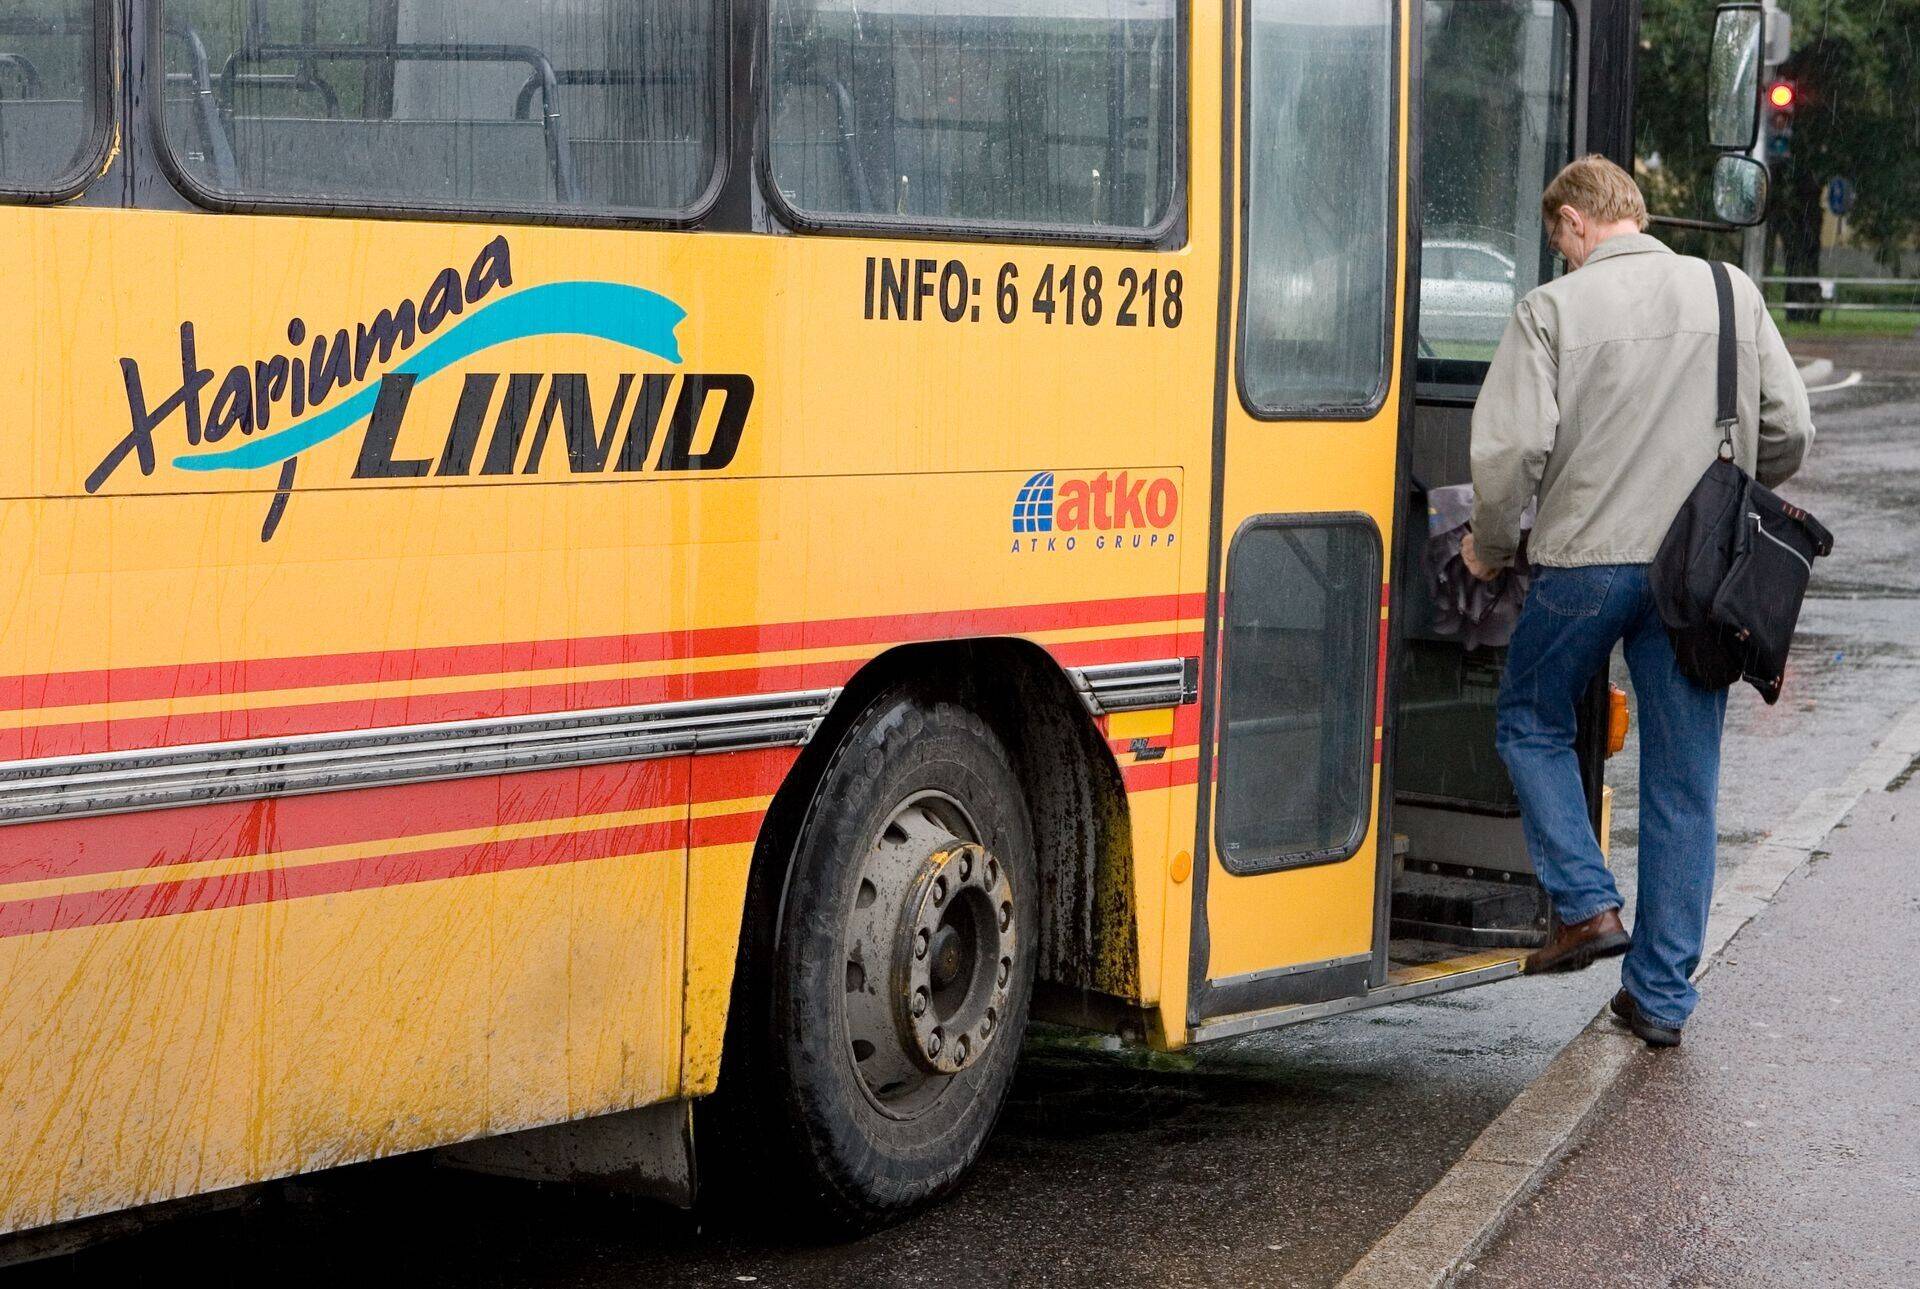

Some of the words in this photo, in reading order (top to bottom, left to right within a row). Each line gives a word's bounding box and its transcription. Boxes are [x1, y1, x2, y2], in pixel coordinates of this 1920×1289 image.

[863, 256, 981, 323] INFO:
[996, 261, 1019, 324] 6
[1032, 263, 1103, 327] 418
[1115, 267, 1183, 329] 218
[84, 235, 514, 543] Harjumaa
[351, 372, 755, 479] LIINID
[1056, 470, 1179, 531] atko
[1011, 536, 1076, 553] ATKO
[1095, 533, 1176, 551] GRUPP
